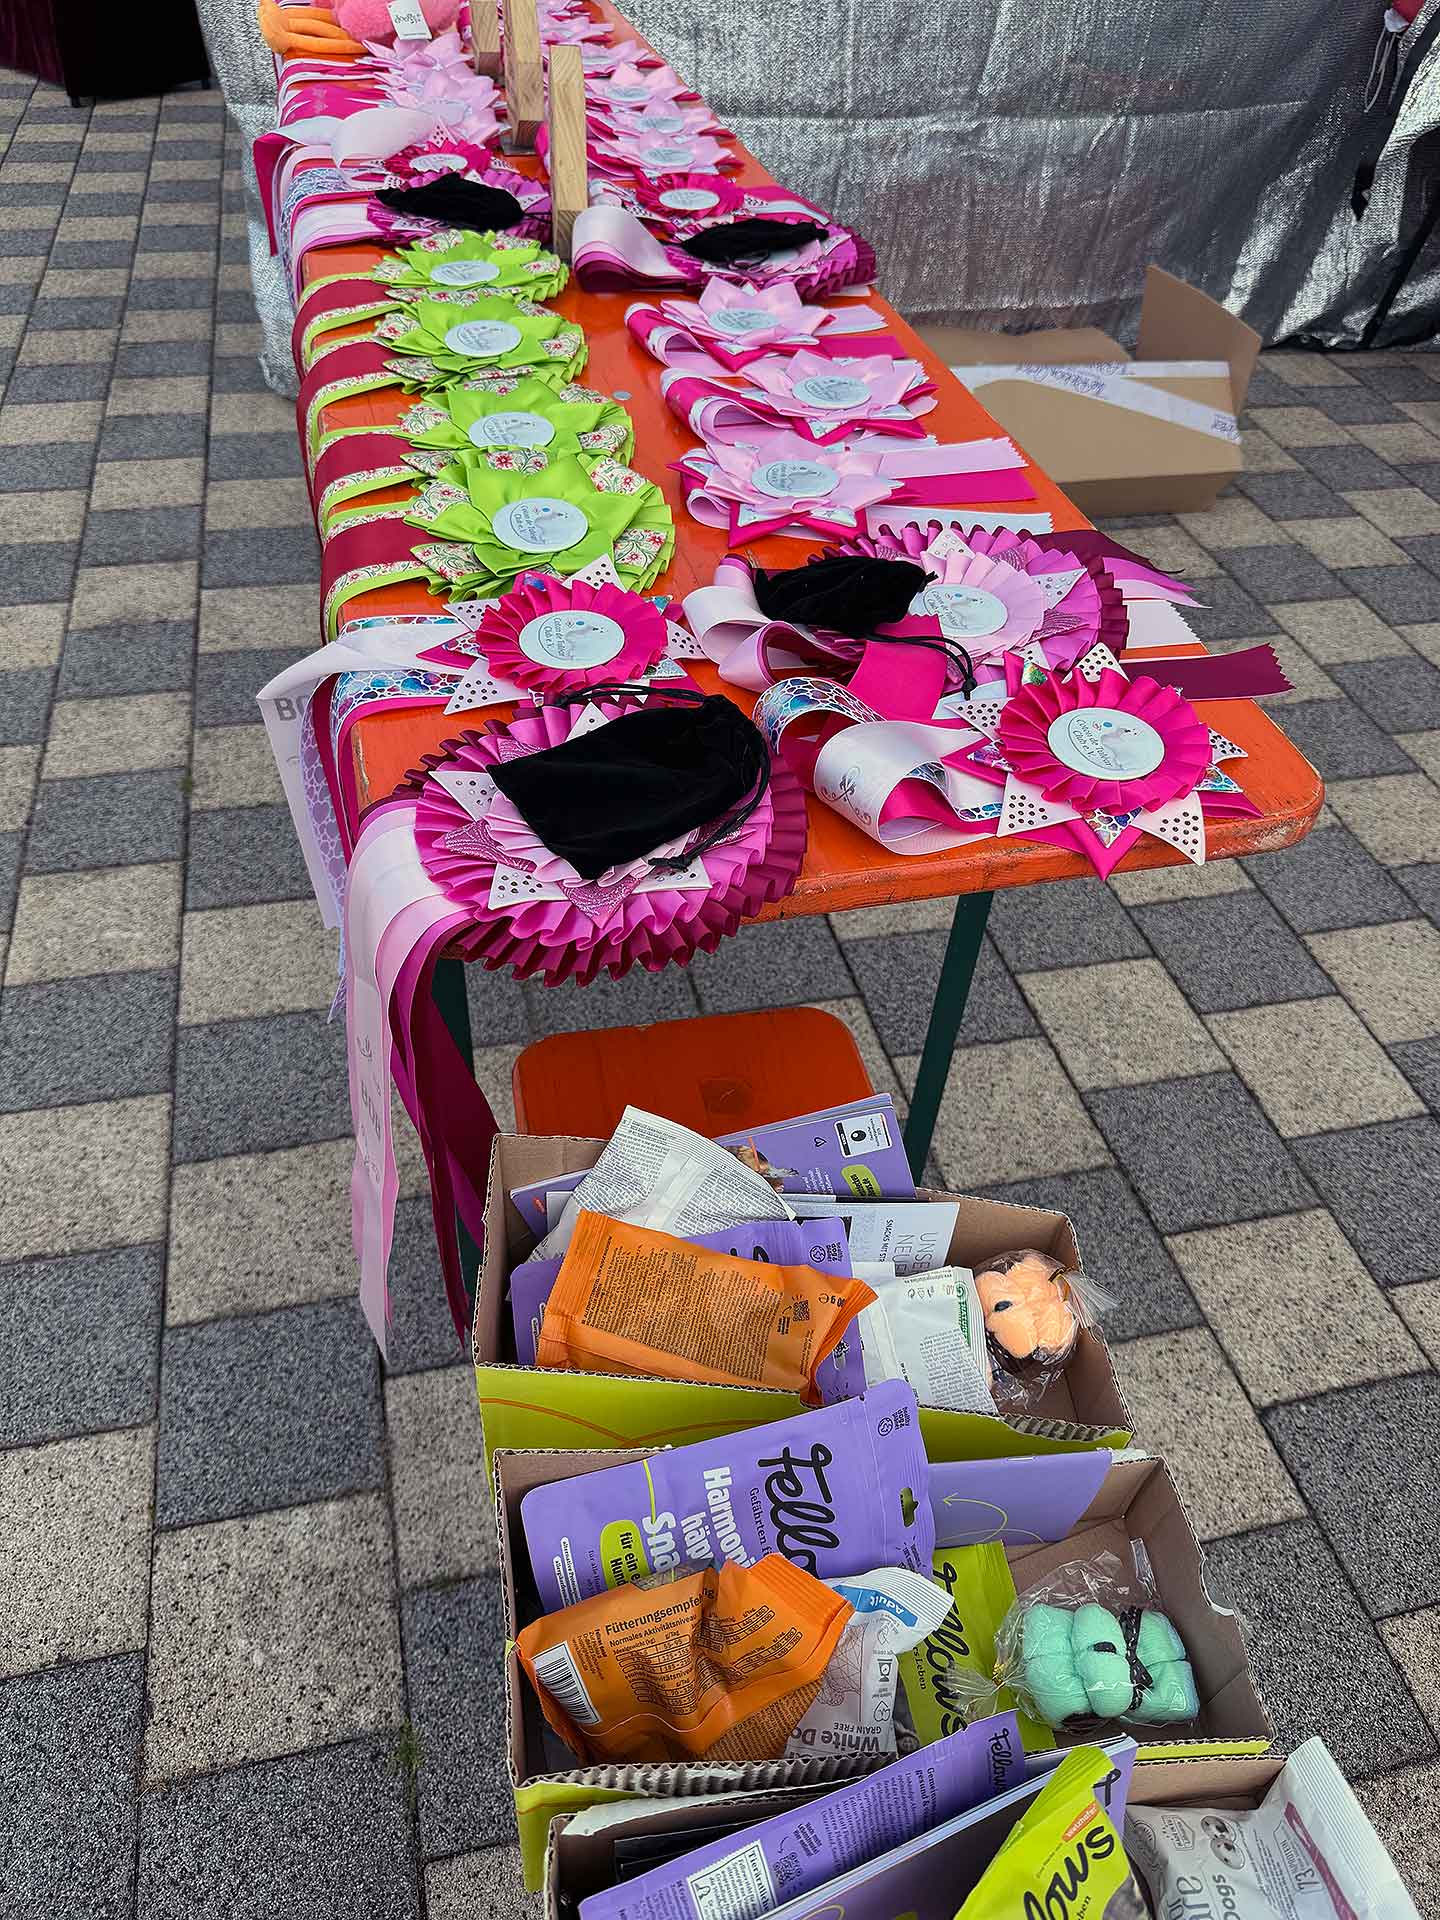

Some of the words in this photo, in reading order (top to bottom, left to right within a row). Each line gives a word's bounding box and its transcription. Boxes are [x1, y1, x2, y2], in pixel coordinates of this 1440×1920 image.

[749, 1487, 767, 1545] Gefährten
[619, 1532, 633, 1549] für
[624, 1552, 639, 1574] ein
[869, 1595, 905, 1614] Adult
[609, 1633, 643, 1647] Normales
[914, 1658, 926, 1690] Leben
[834, 1722, 855, 1733] FREE
[855, 1725, 881, 1735] GRAIN
[821, 1728, 880, 1751] White
[1295, 1869, 1321, 1891] 73
